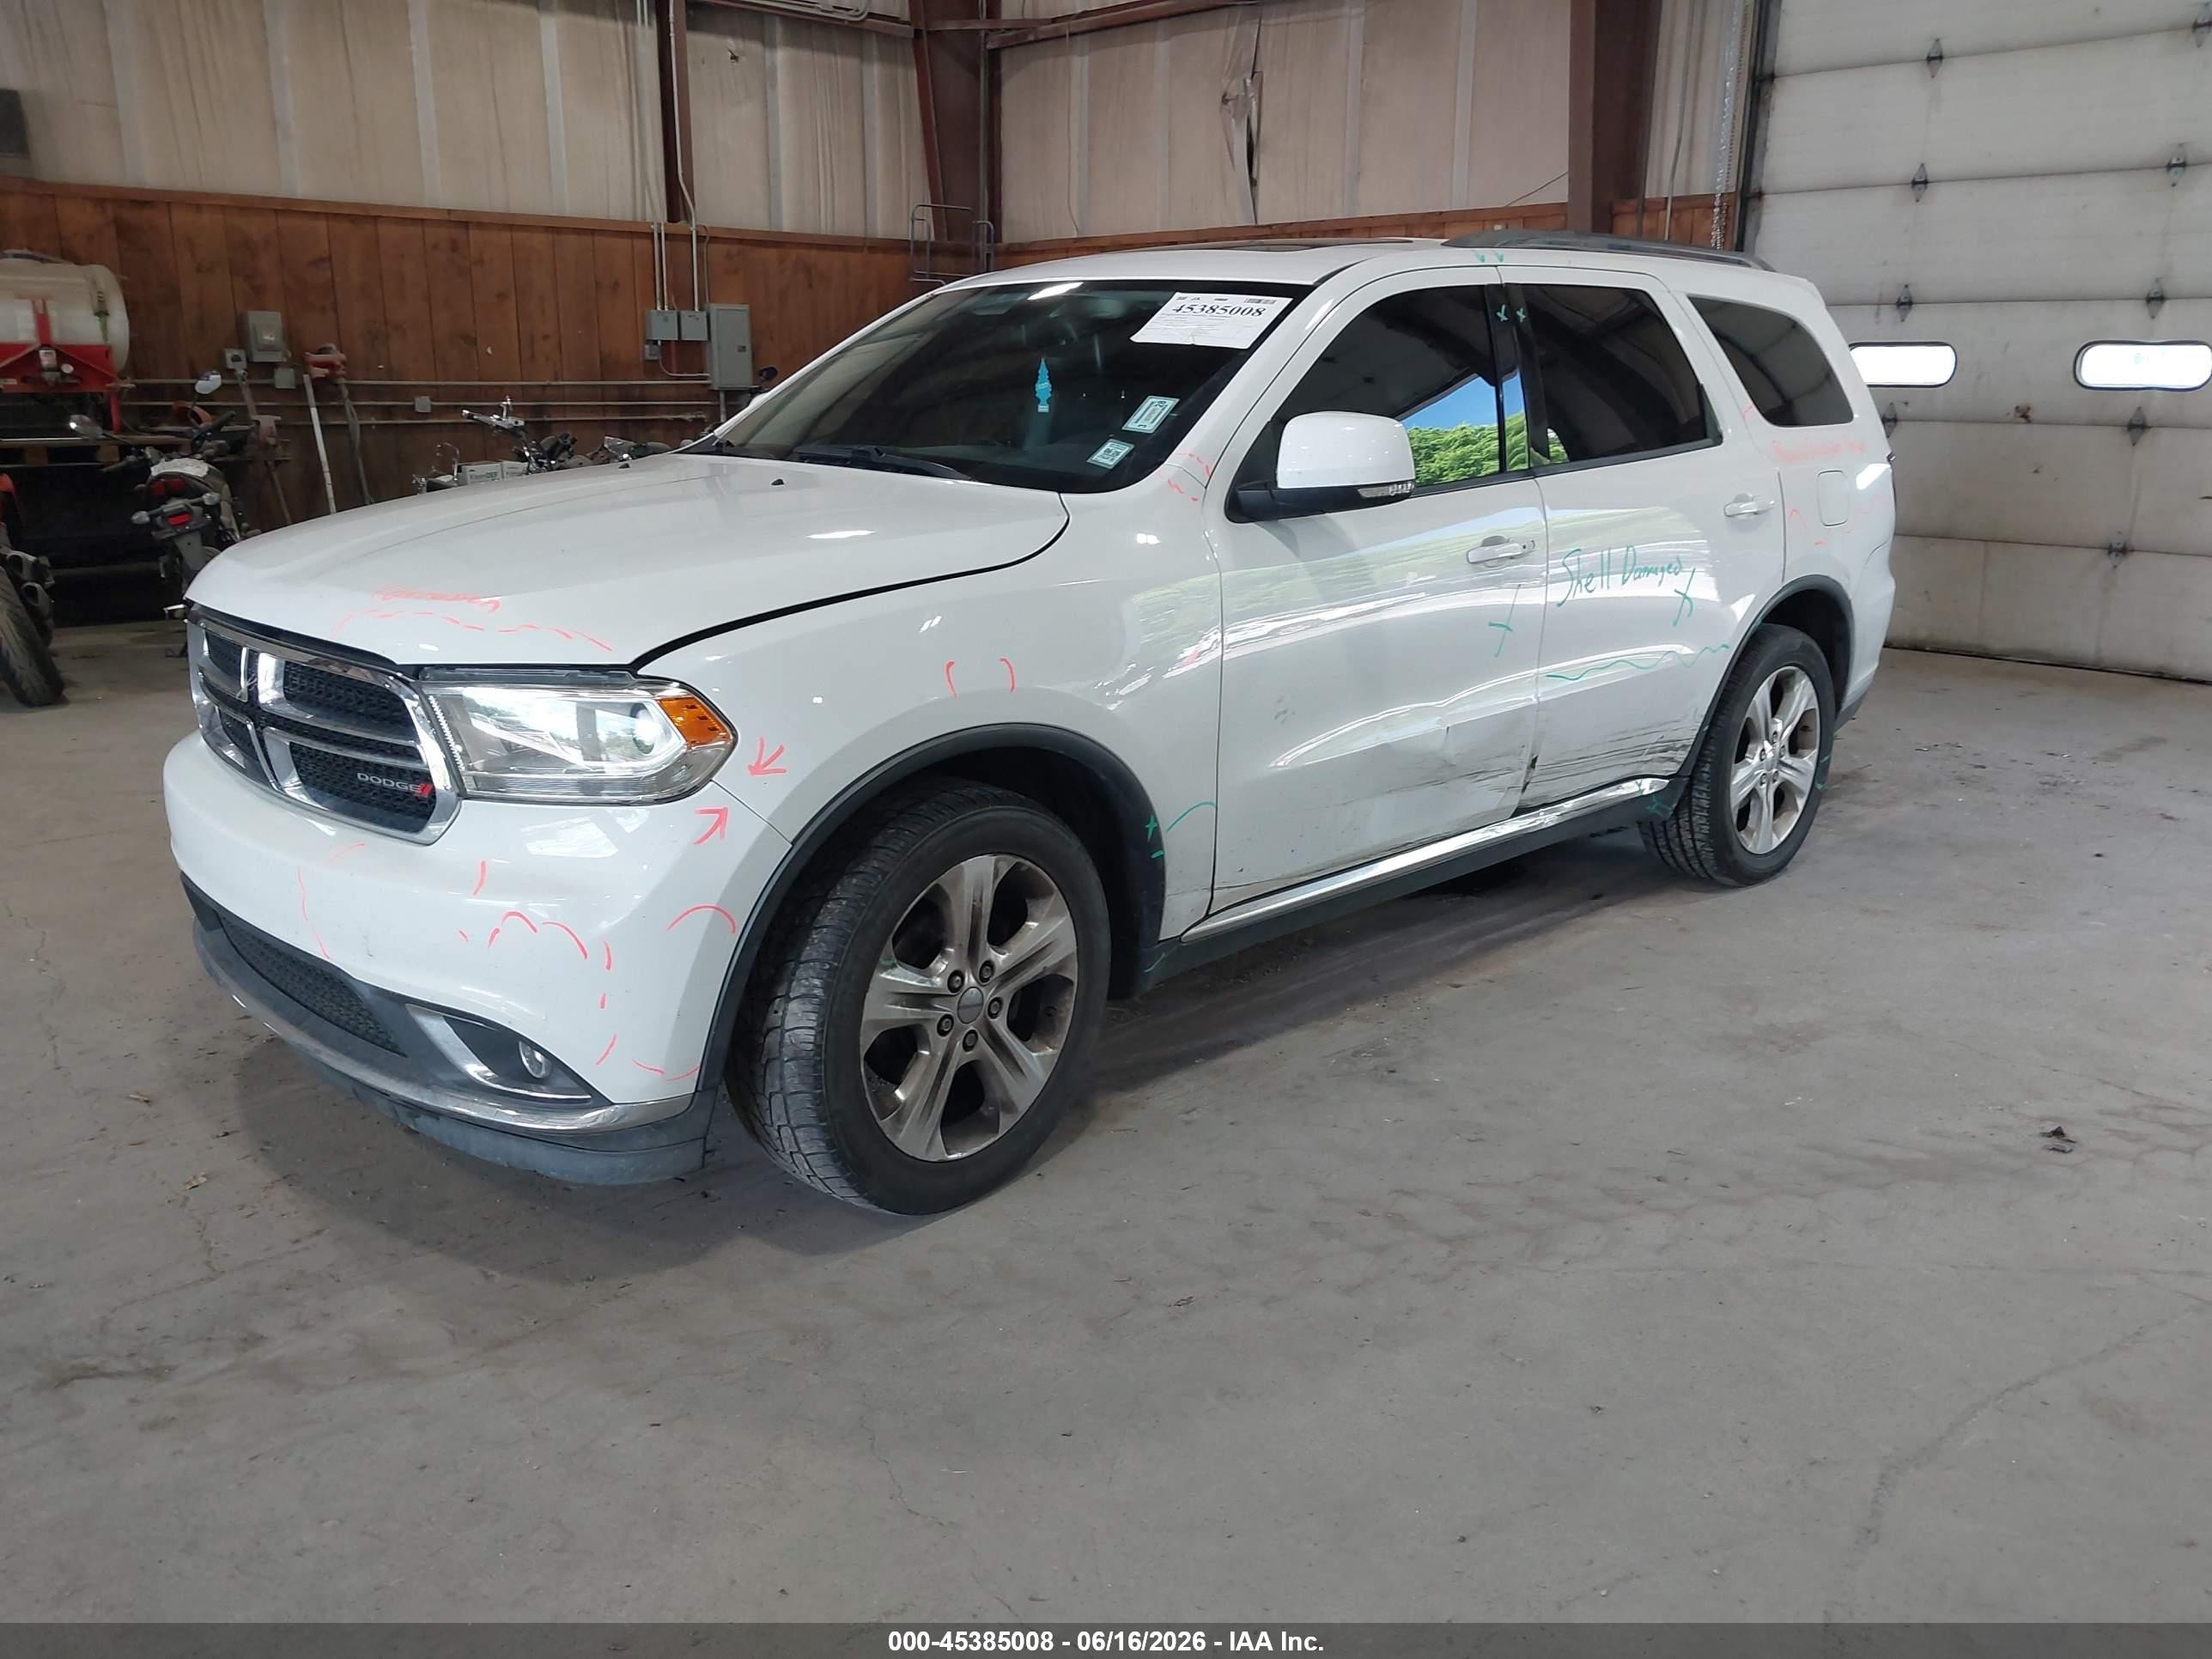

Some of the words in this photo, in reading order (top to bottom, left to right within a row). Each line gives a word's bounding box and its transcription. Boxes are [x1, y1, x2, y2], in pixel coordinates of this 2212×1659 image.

[1172, 303, 1267, 317] 45385008
[1557, 547, 1612, 607] Shell
[356, 772, 422, 793] DODGE
